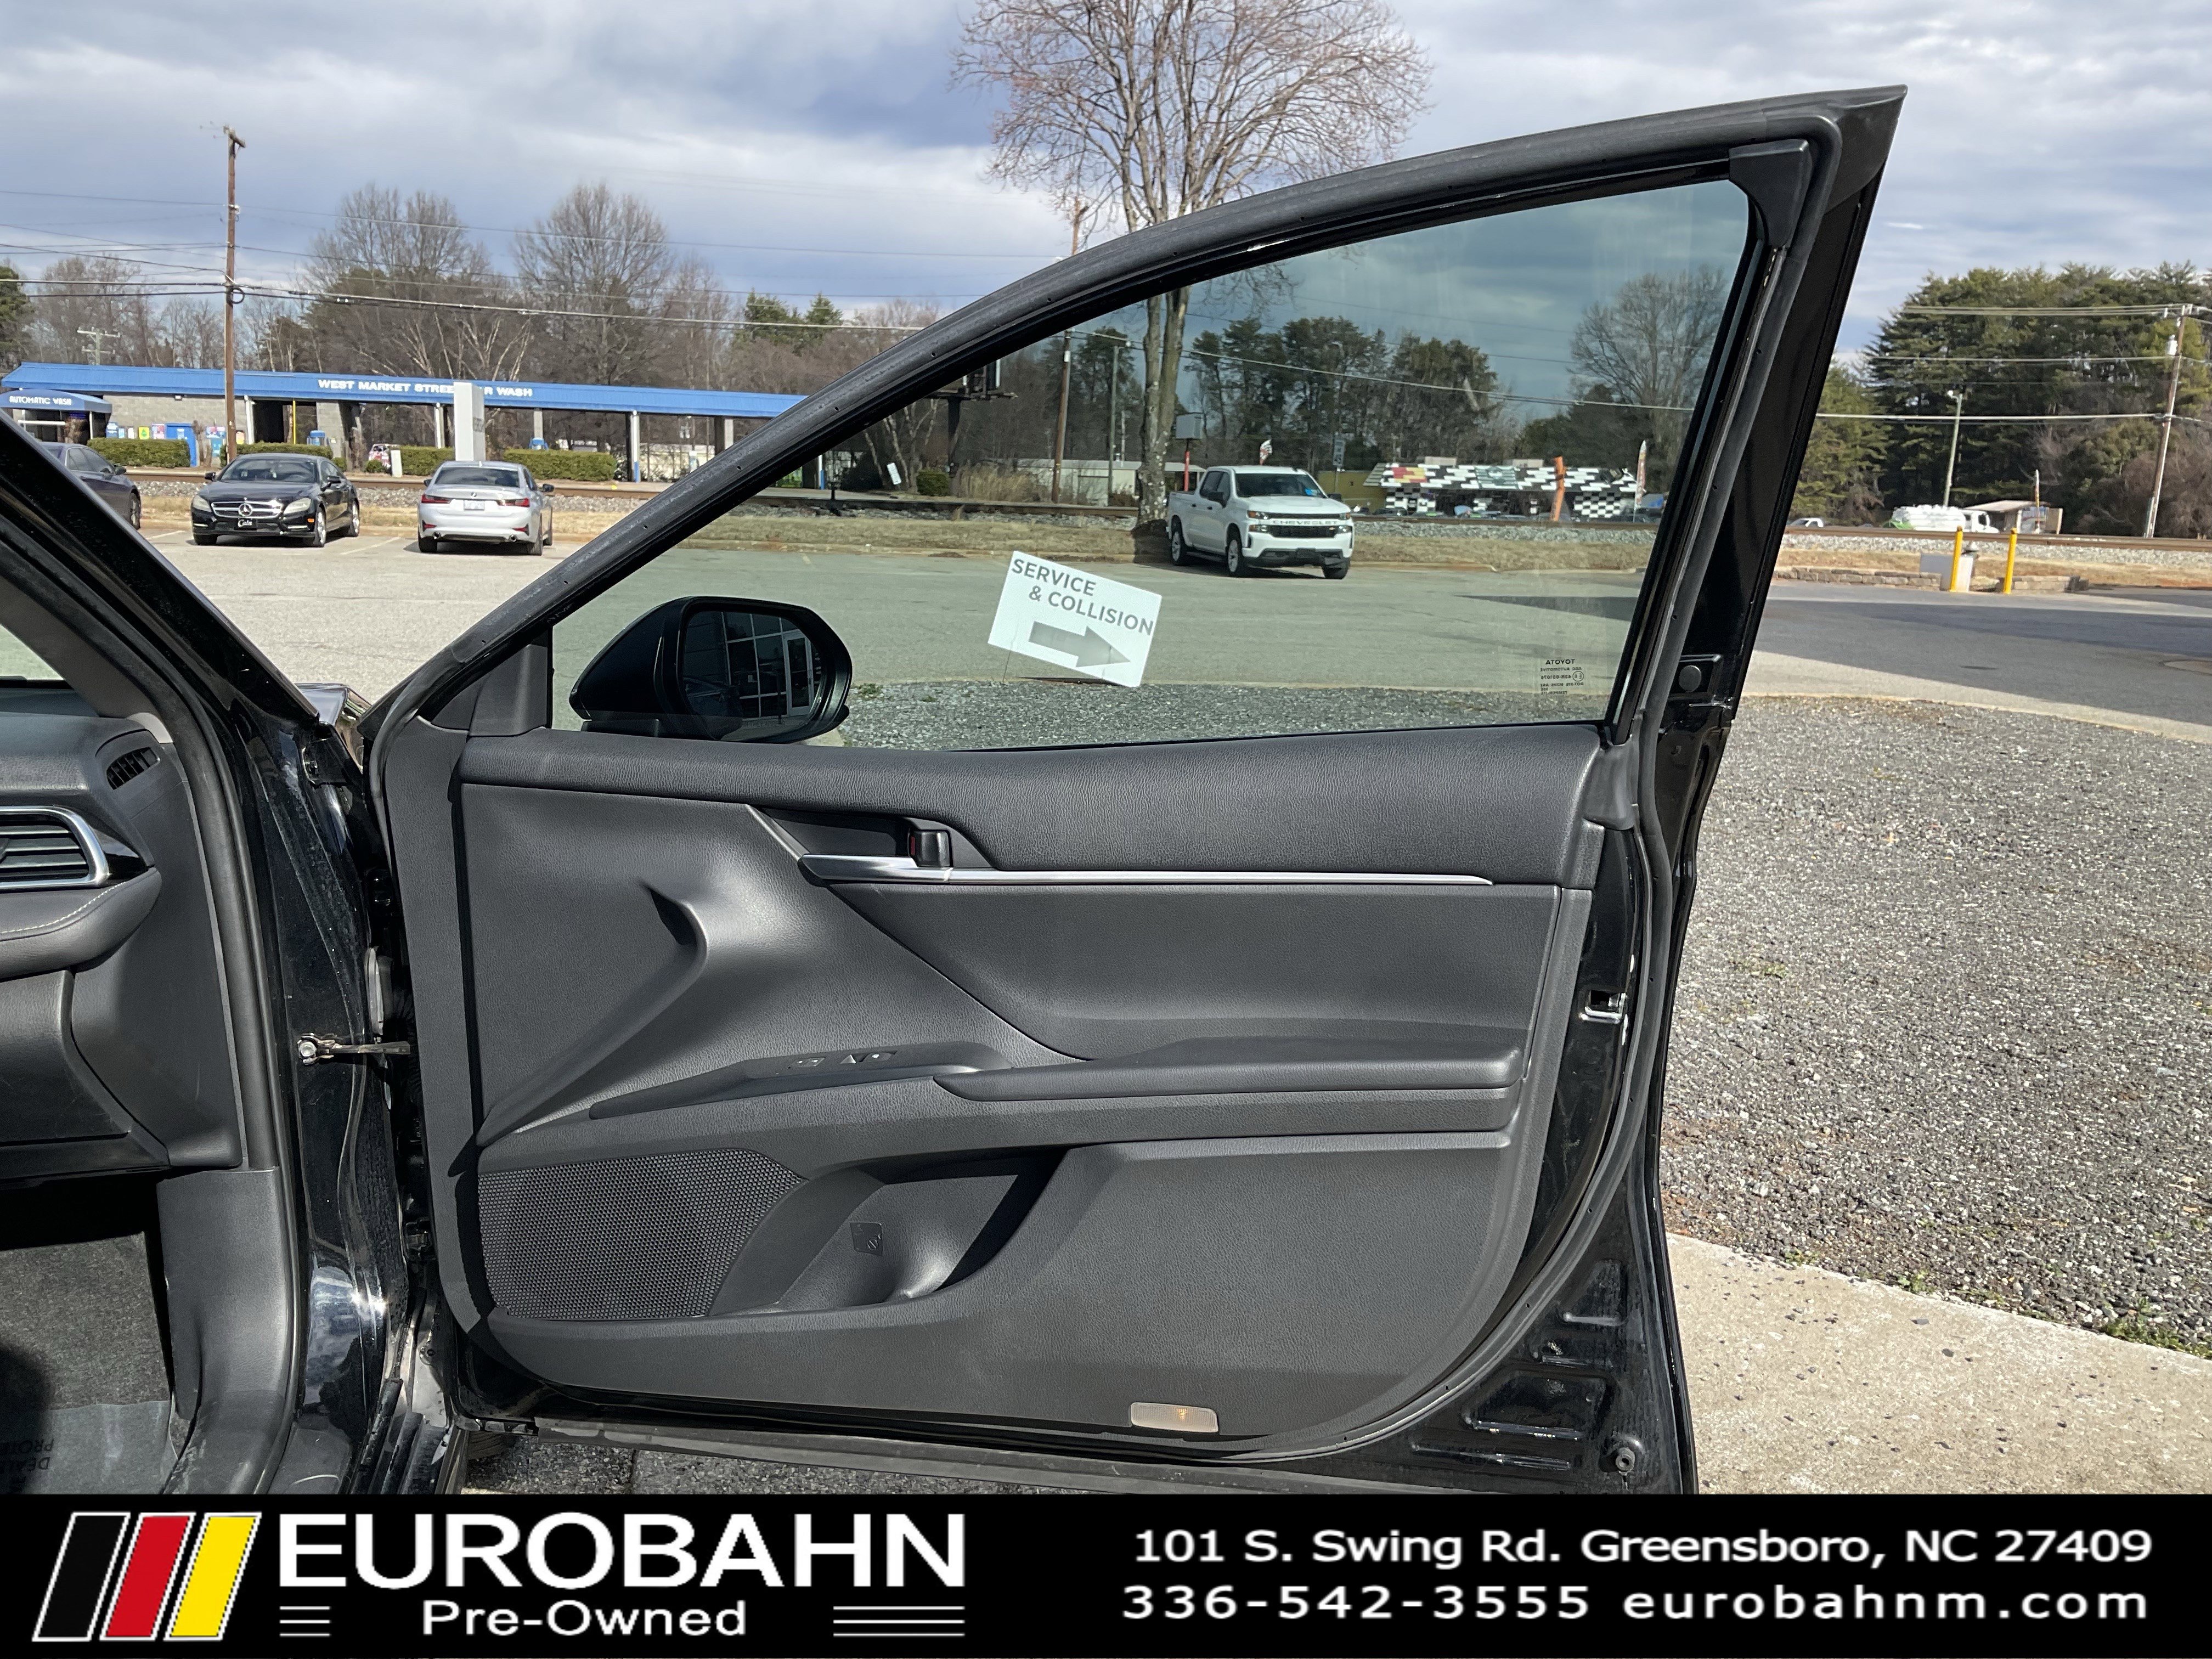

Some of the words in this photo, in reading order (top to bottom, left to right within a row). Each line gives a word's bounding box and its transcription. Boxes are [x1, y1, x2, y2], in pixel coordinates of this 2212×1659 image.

[318, 380, 355, 389] WEST
[358, 381, 411, 392] MARKET
[414, 383, 454, 393] STREE
[496, 387, 533, 397] WASH
[9, 396, 50, 404] AUTOMATIC
[1011, 558, 1096, 596] SERVICE
[1029, 585, 1042, 602] &
[1048, 591, 1154, 636] COLLISION
